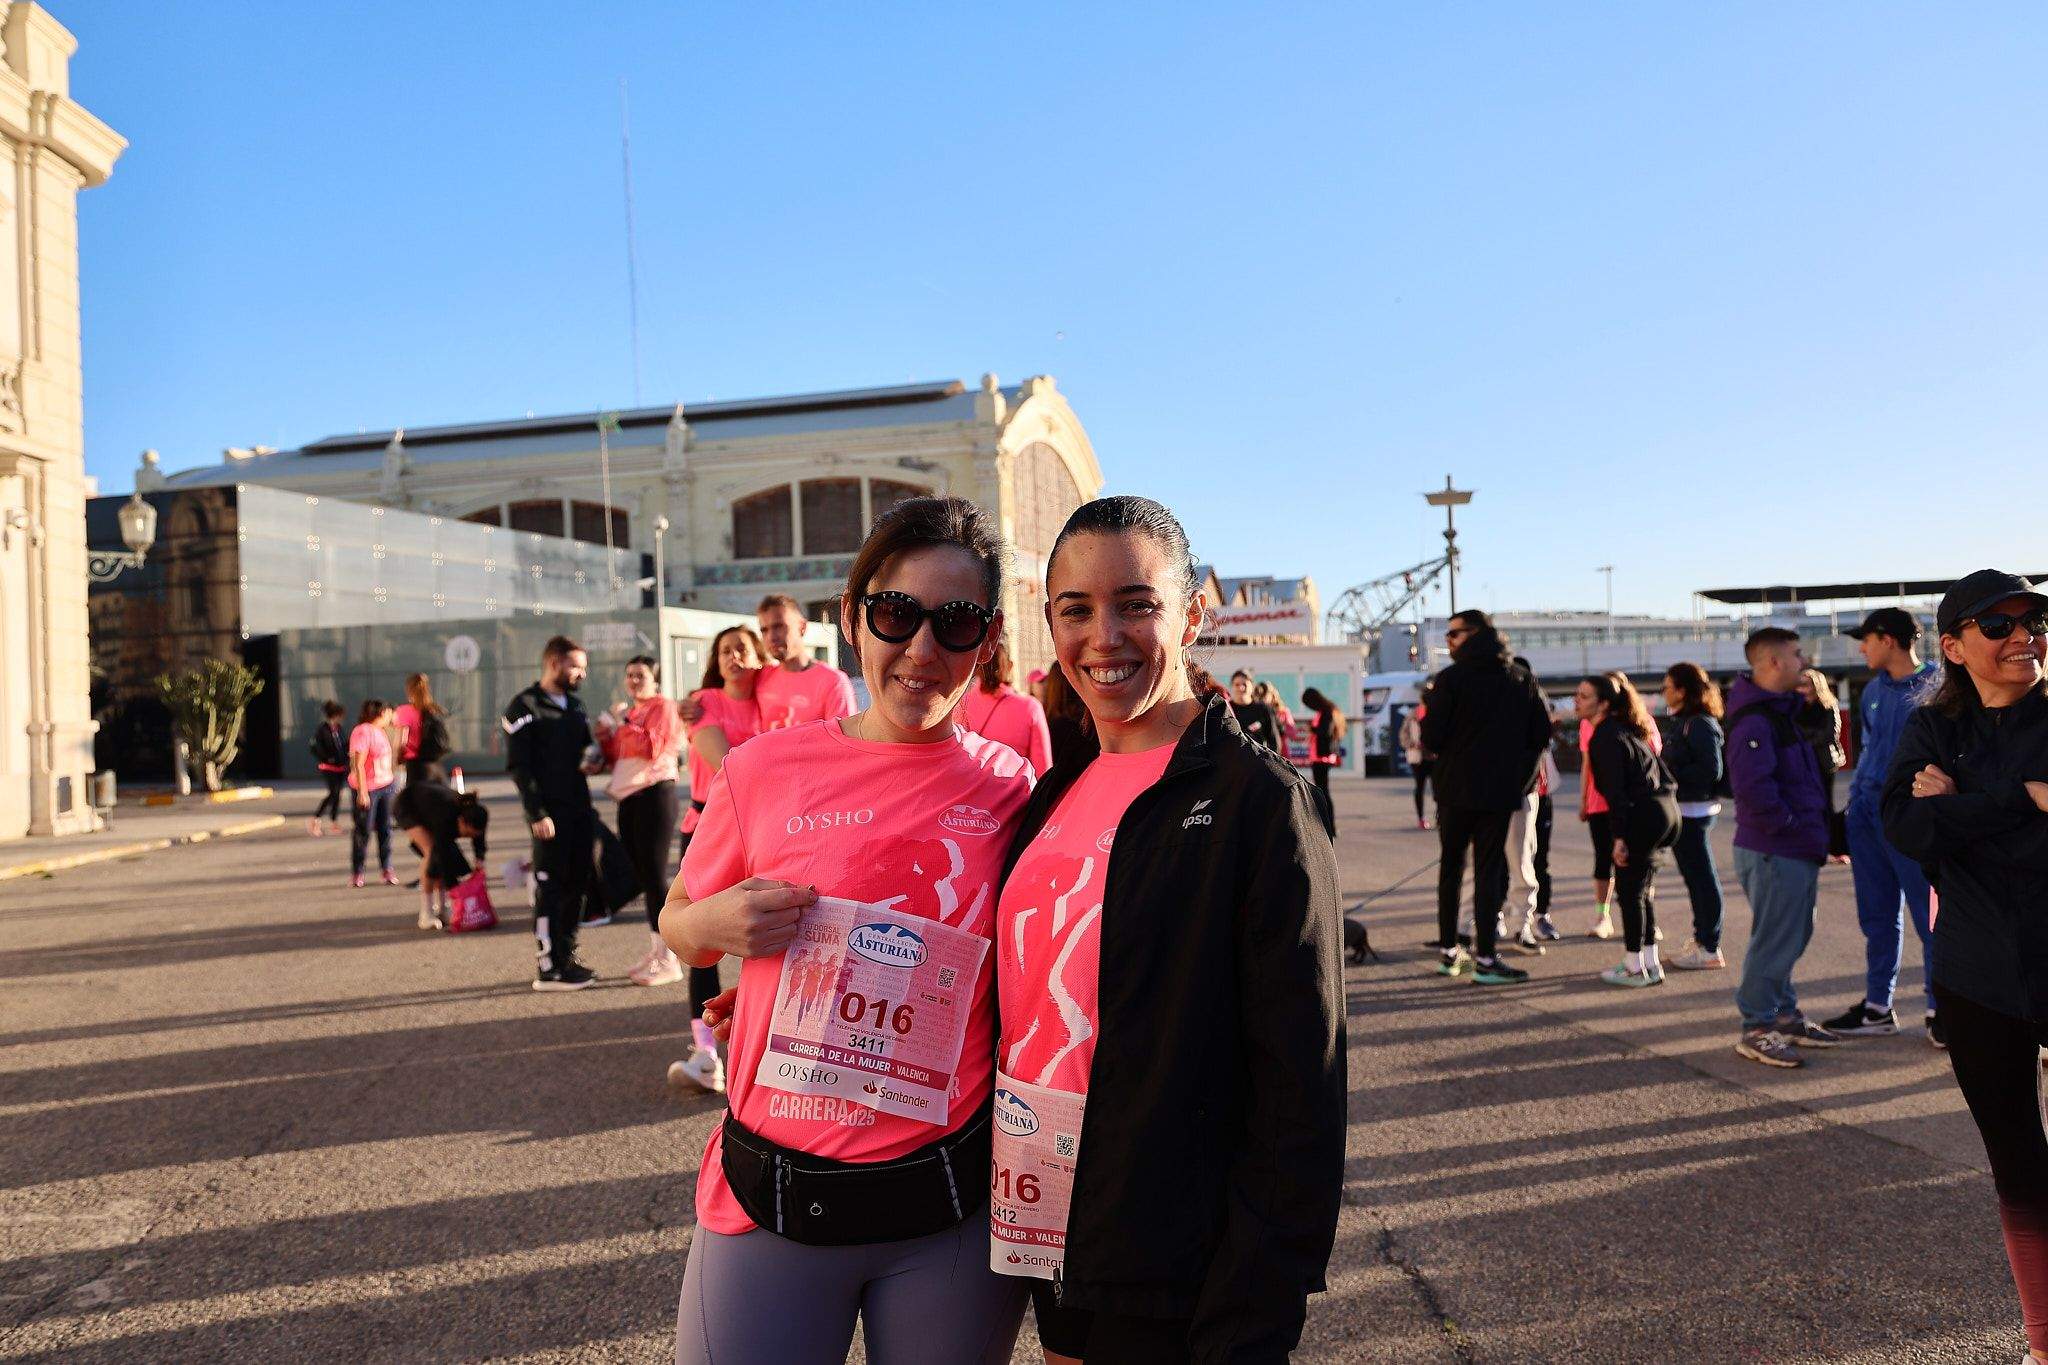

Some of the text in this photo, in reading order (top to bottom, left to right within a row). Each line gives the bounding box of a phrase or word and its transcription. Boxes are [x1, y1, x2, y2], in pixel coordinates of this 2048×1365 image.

[786, 808, 874, 834] OYSHO
[1182, 814, 1213, 829] ipso
[804, 931, 840, 946] SUMA
[814, 923, 841, 934] DORSAL
[852, 931, 923, 962] ASTURIANA
[840, 992, 915, 1034] 016
[848, 1033, 885, 1054] 3411
[789, 1041, 930, 1083] CARRERA DE LA MUJER VALENCIA
[778, 1062, 839, 1086] OYSHO
[769, 1093, 848, 1121] CARRERA
[878, 1086, 930, 1109] Santander
[997, 1225, 1027, 1240] MUJER
